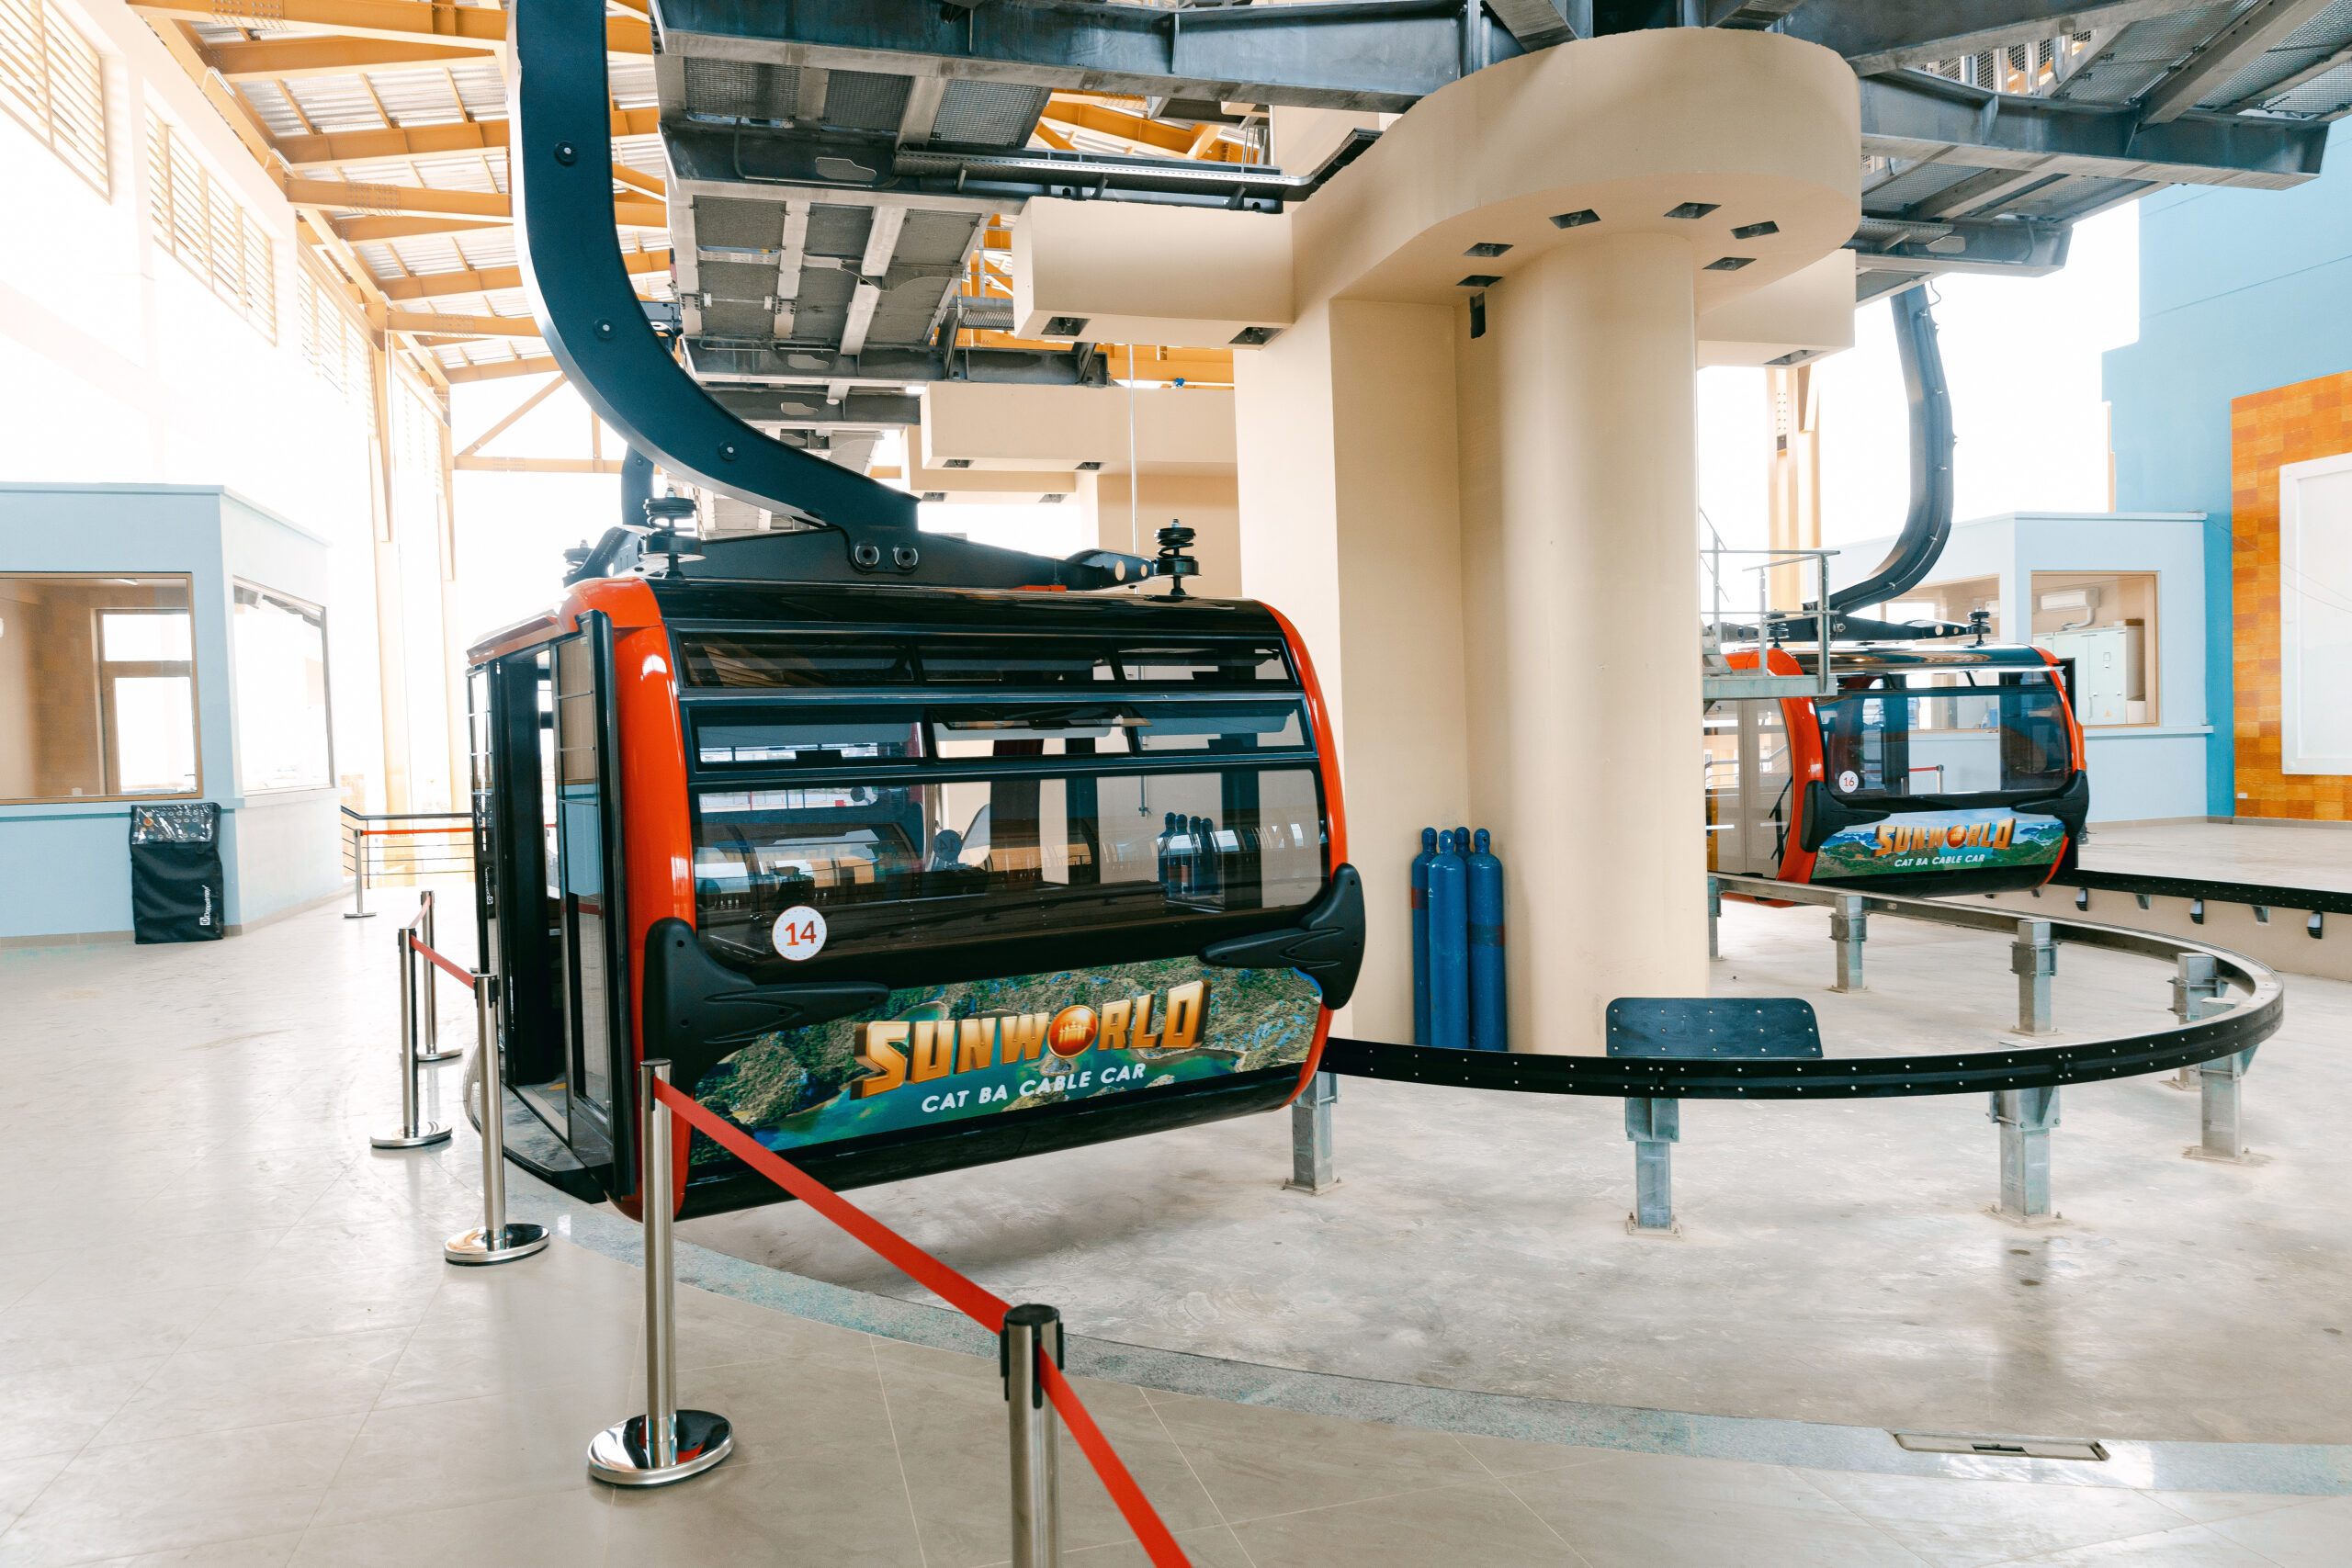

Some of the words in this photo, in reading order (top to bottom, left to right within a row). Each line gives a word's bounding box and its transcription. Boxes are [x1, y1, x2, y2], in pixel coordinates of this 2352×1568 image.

[1844, 776, 1855, 787] 16
[1894, 857, 1914, 867] CAT
[1916, 856, 1928, 866] BA
[1932, 855, 1962, 865] CABLE
[1964, 853, 1985, 863] CAR
[785, 920, 817, 946] 14
[922, 1090, 969, 1112] CAT
[978, 1084, 1008, 1104] BA
[1019, 1071, 1091, 1097] CABLE
[1100, 1063, 1147, 1084] CAR
